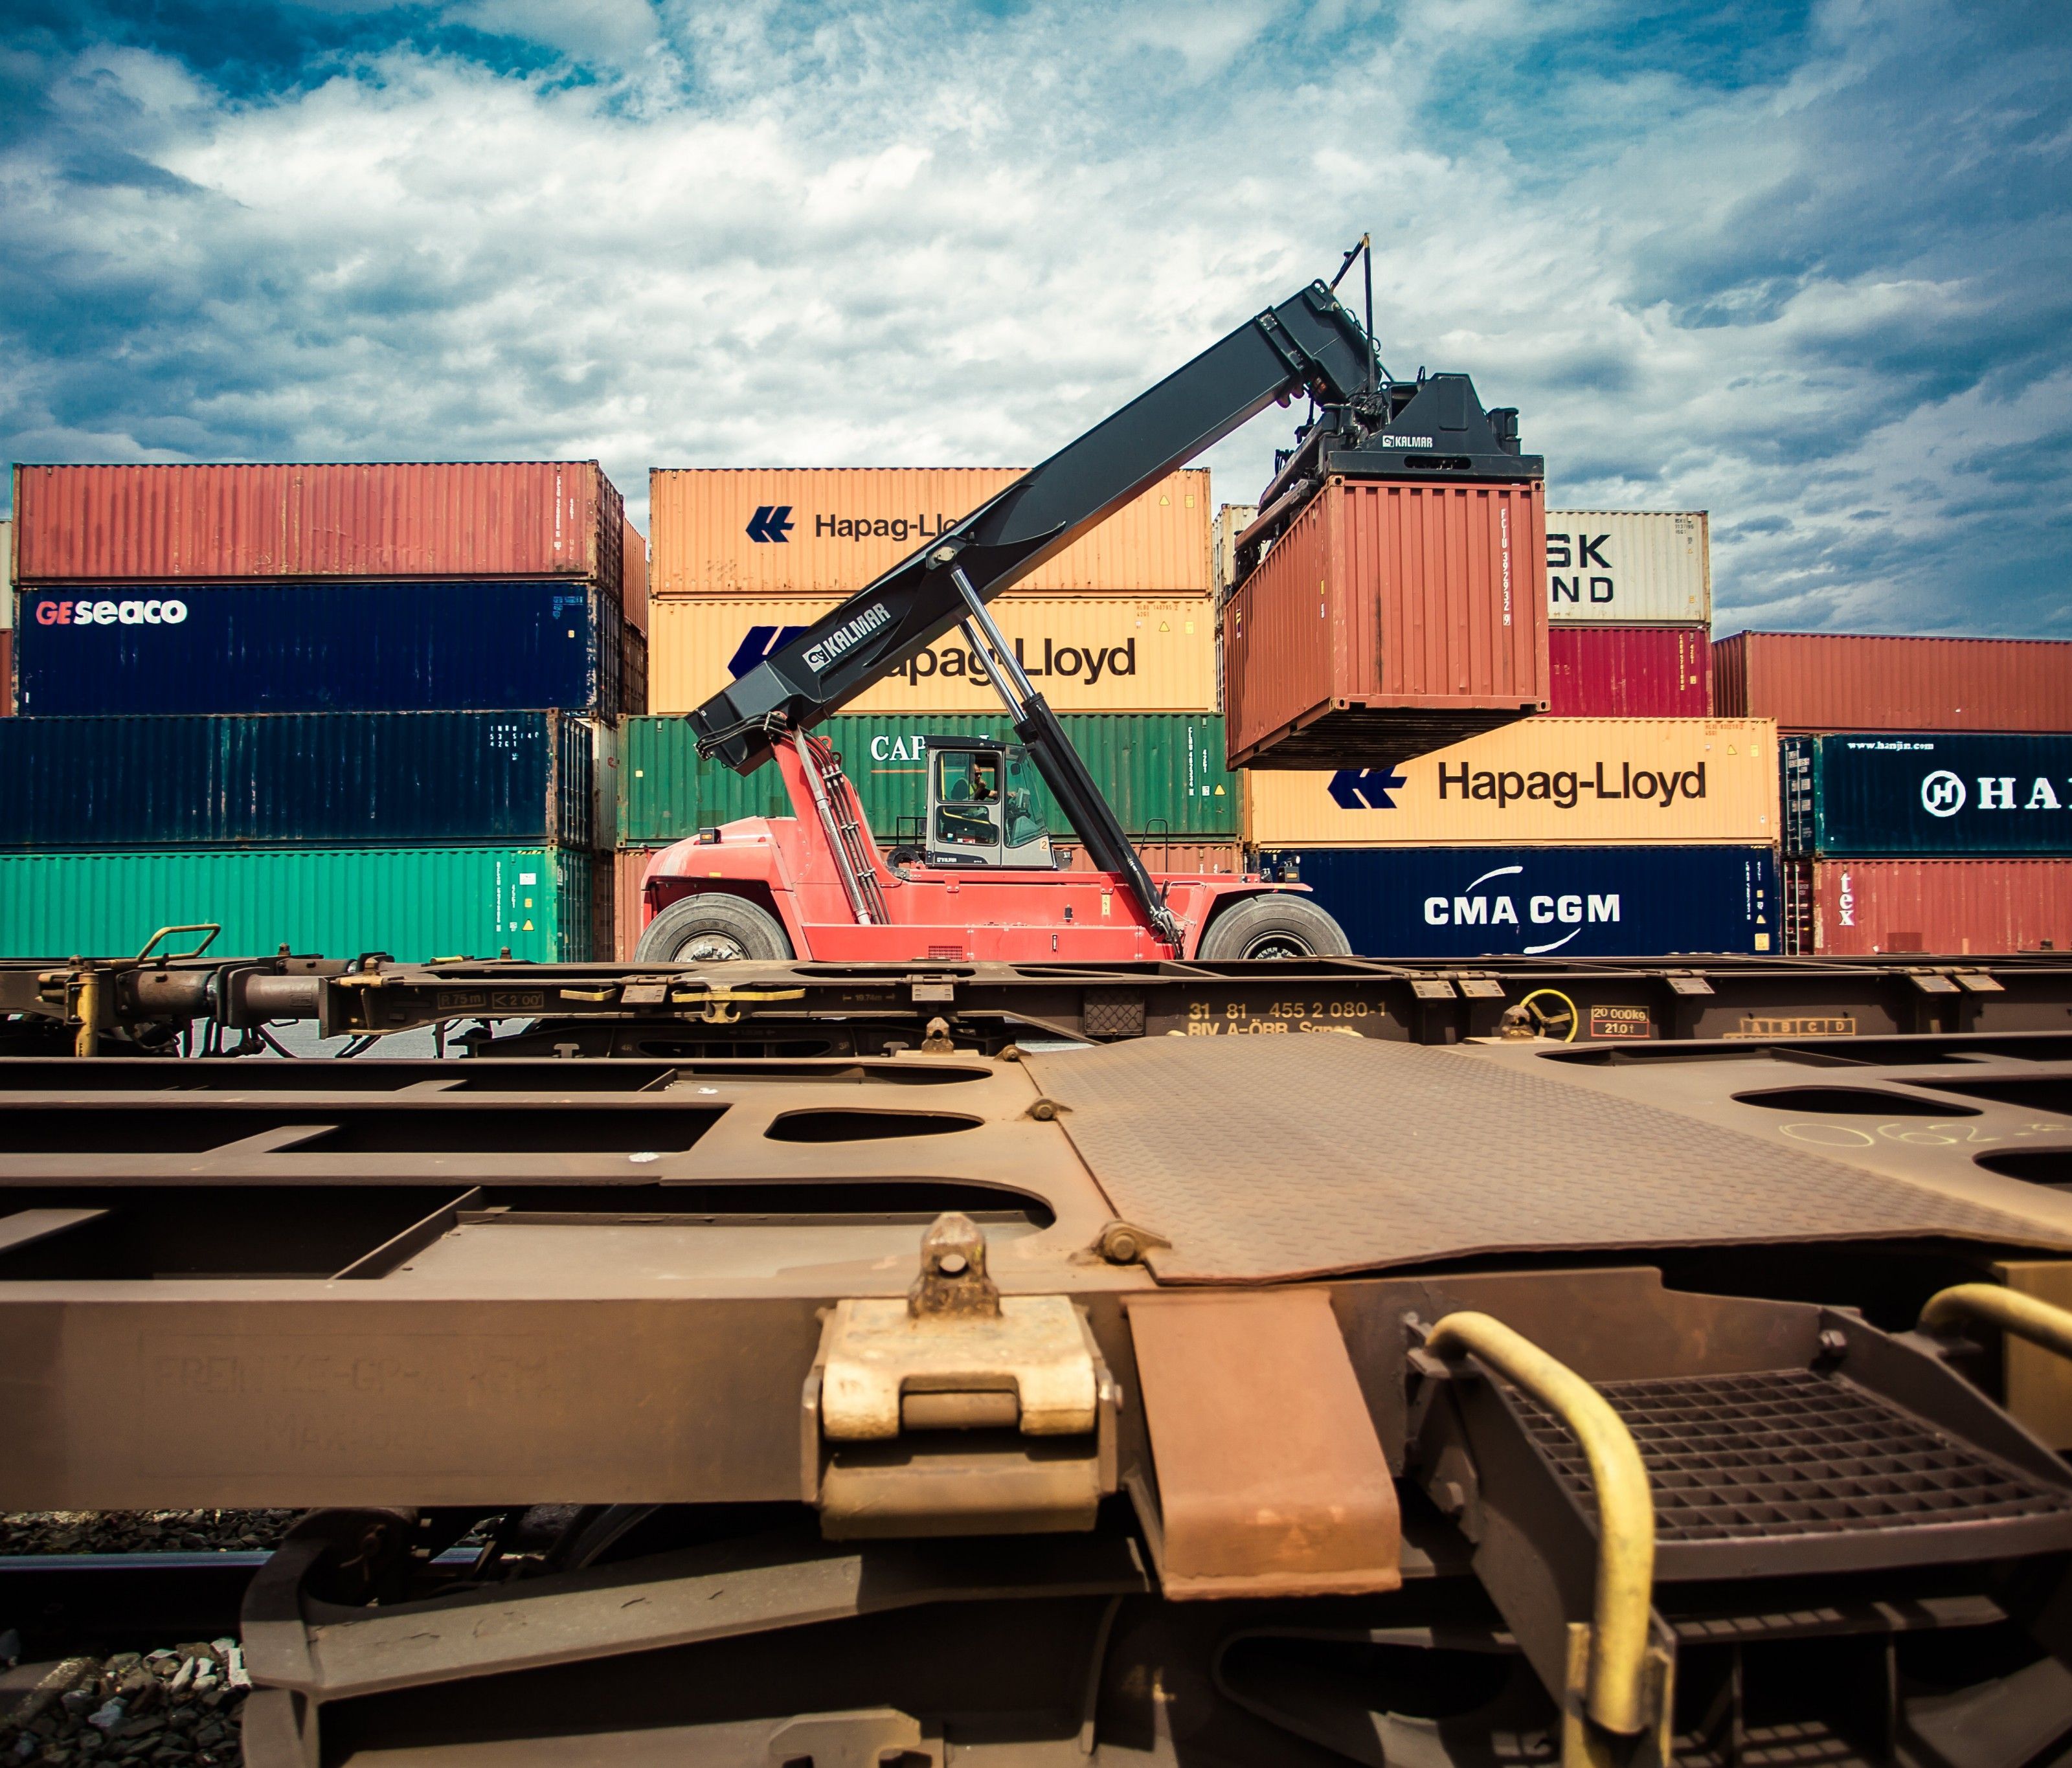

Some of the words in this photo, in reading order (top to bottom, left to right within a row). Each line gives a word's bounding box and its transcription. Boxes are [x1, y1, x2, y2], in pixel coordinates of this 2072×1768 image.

[1395, 436, 1433, 448] KALMAR
[822, 603, 891, 658] KALMAR
[1847, 741, 1935, 752] www.hanjin.com
[1438, 761, 1707, 808] Hapag-Lloyd
[1977, 777, 2072, 810] HA
[1424, 895, 1518, 926] CMA
[1529, 893, 1621, 924] CGM
[1839, 873, 1855, 926] tex
[1189, 1003, 1210, 1020] 31
[1226, 1003, 1247, 1019] 81
[1269, 1002, 1305, 1018] 455
[1311, 1003, 1323, 1018] 2
[1330, 1001, 1386, 1018] 080-1
[1593, 1007, 1608, 1018] 20
[1610, 1007, 1646, 1022] 000kg
